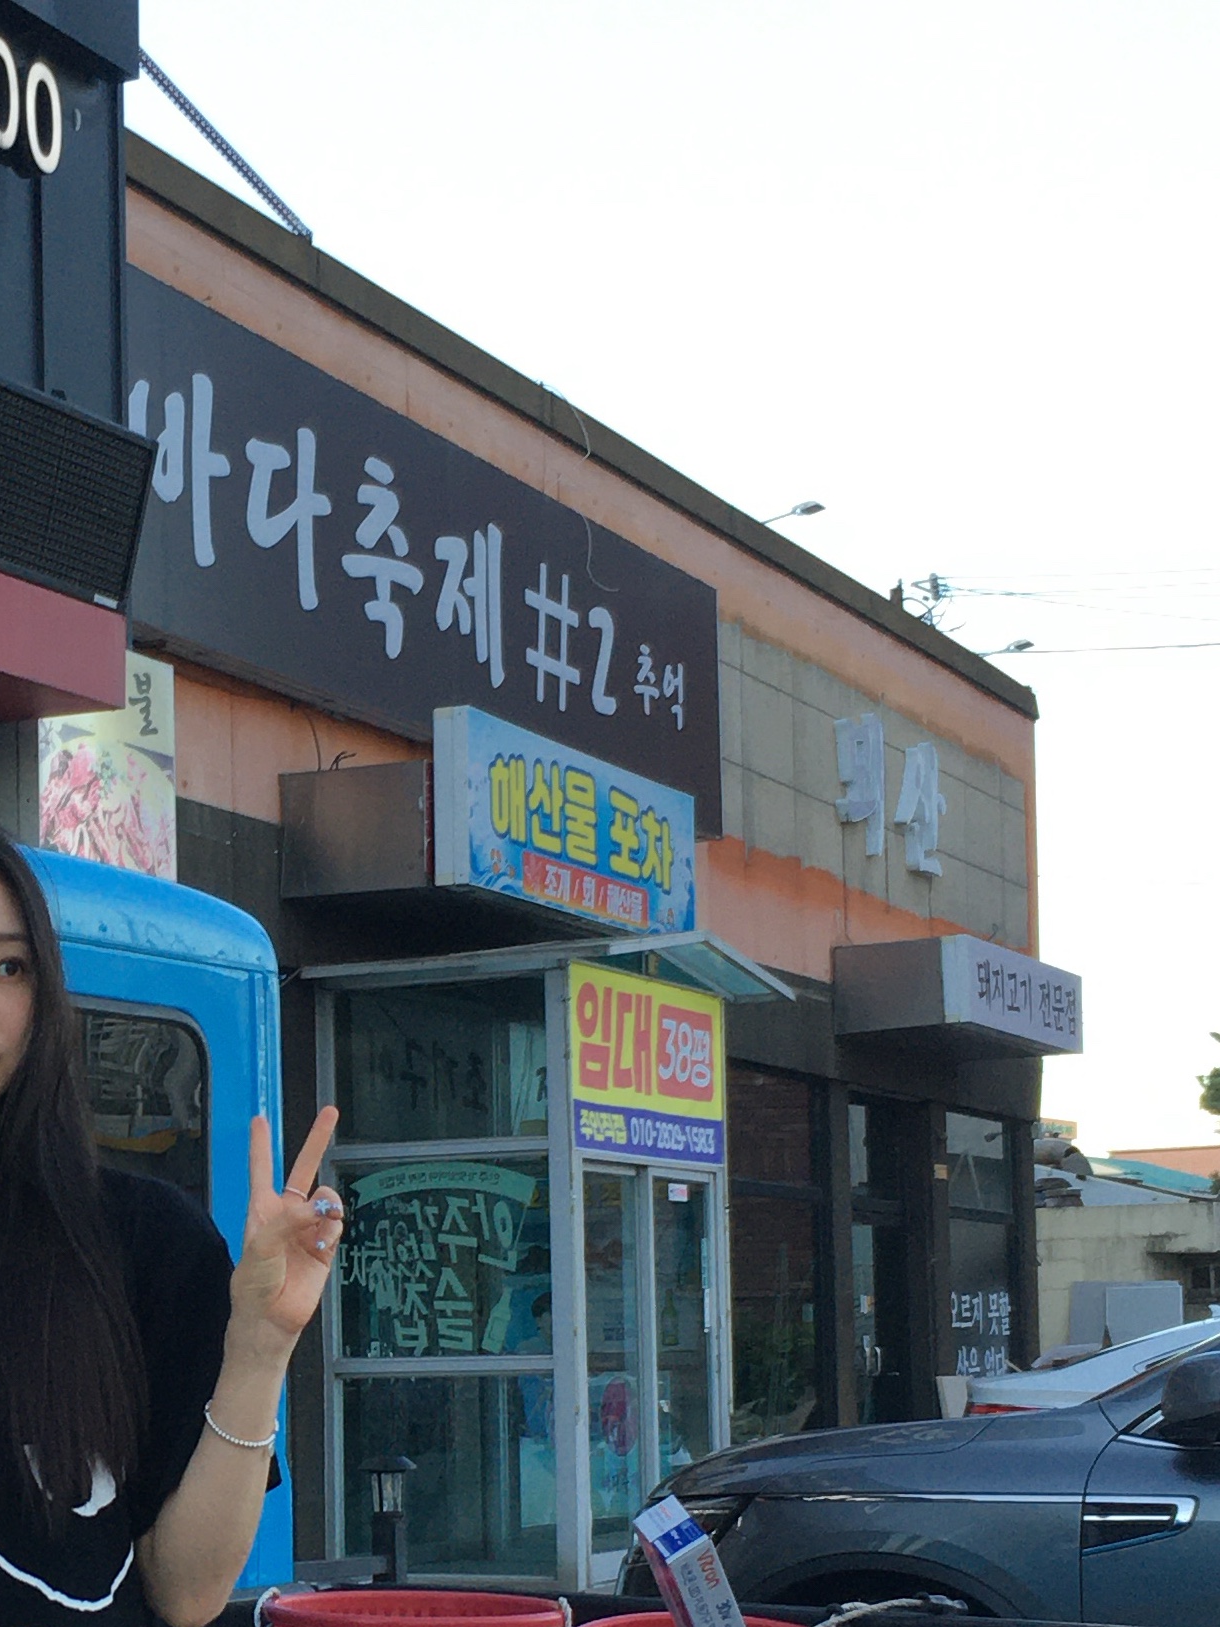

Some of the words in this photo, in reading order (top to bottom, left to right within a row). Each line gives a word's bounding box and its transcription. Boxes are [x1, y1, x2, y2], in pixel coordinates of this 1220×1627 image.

[489, 754, 597, 869] 해산물
[608, 786, 674, 895] 포차
[576, 982, 653, 1096] 임대
[659, 1018, 712, 1088] 38평
[1039, 979, 1076, 1035] 전문점
